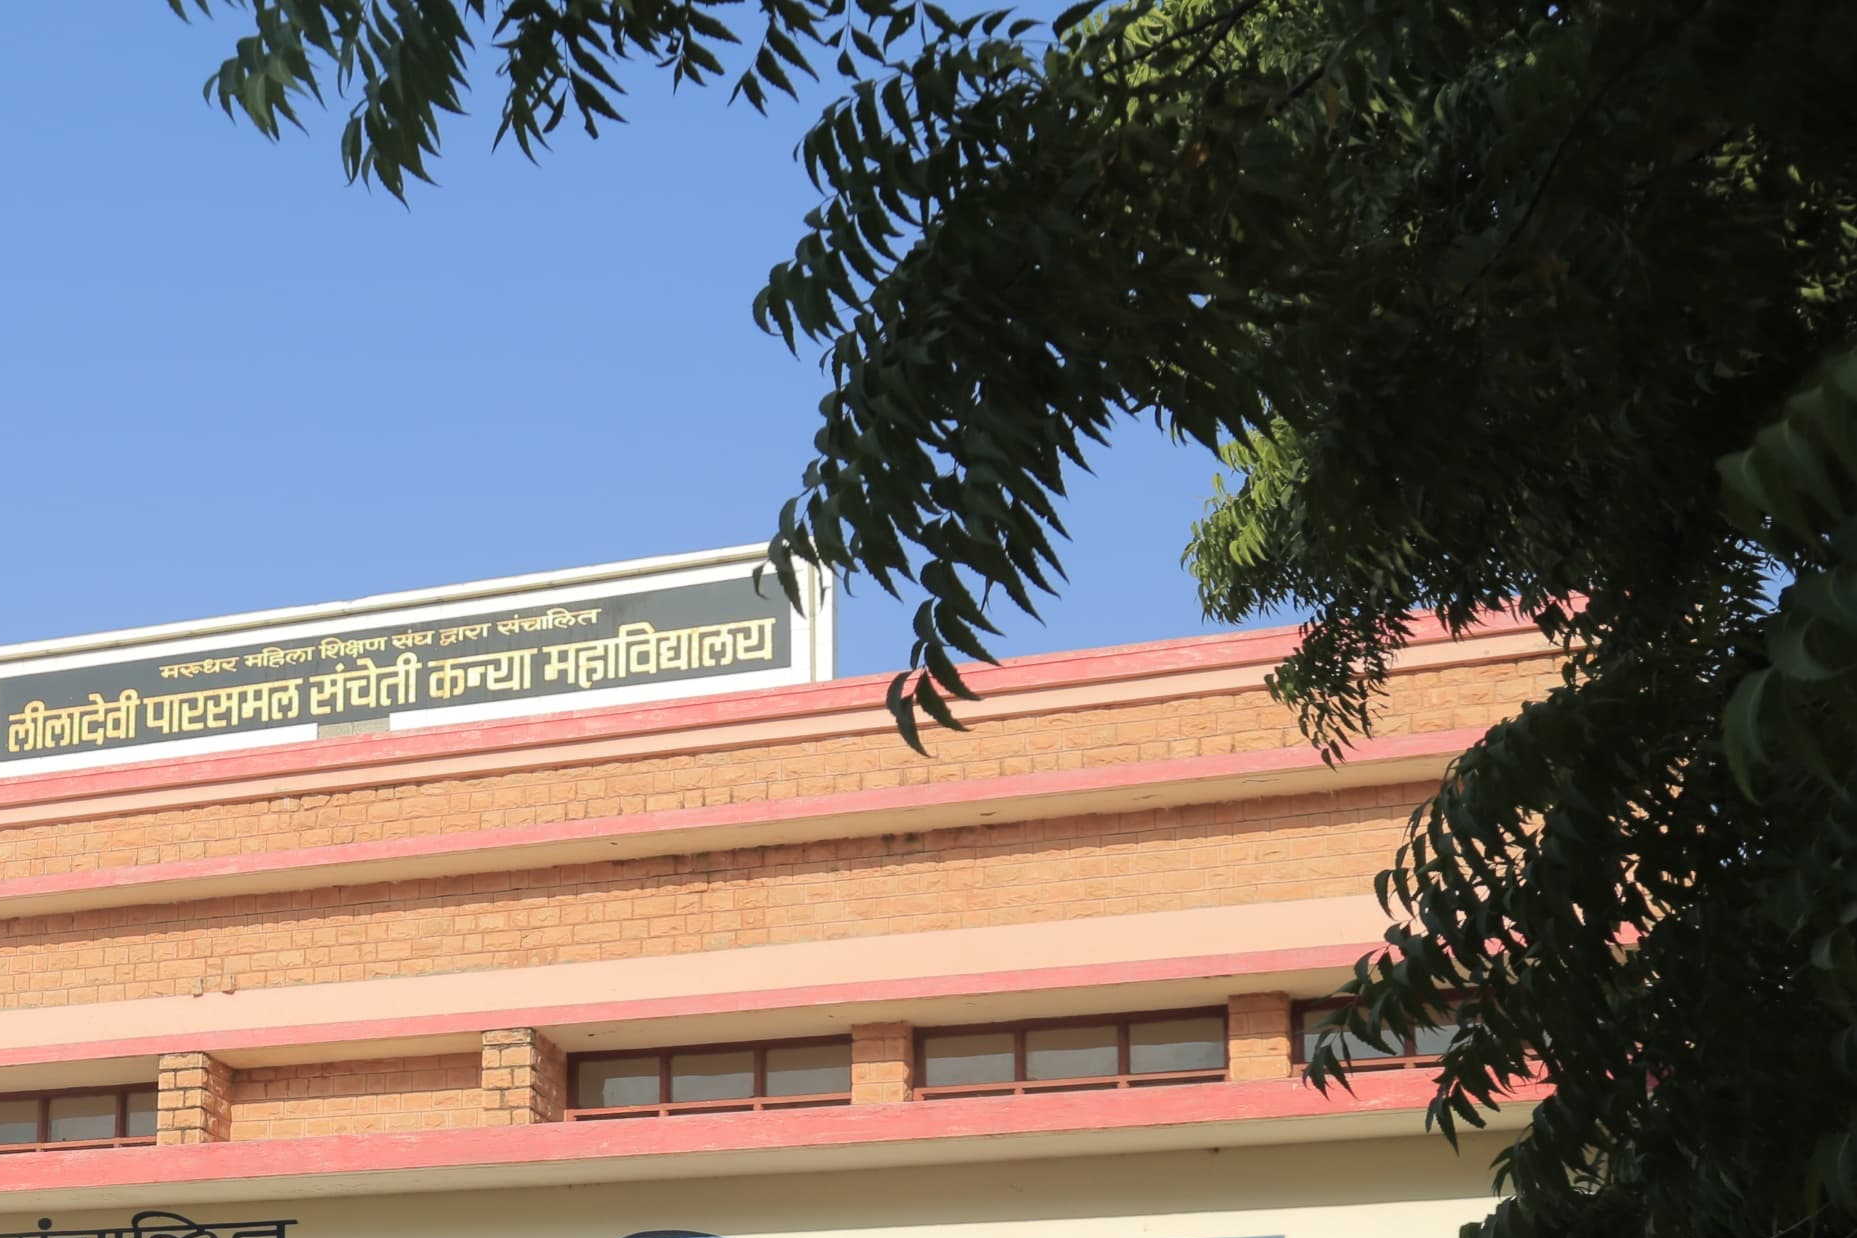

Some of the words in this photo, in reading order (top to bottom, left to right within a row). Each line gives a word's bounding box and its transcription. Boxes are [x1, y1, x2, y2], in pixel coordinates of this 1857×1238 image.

[8, 688, 140, 752] लीलादेवी
[143, 678, 303, 734] पारसमल
[309, 651, 422, 716] संचेती
[428, 648, 538, 699] कन्या
[542, 618, 776, 689] महाविद्यालय
[244, 642, 316, 668] महिला
[319, 637, 387, 660] शिक्षण
[392, 629, 435, 649] संघ
[439, 623, 491, 647] द्वारा
[496, 608, 602, 636] संचालित
